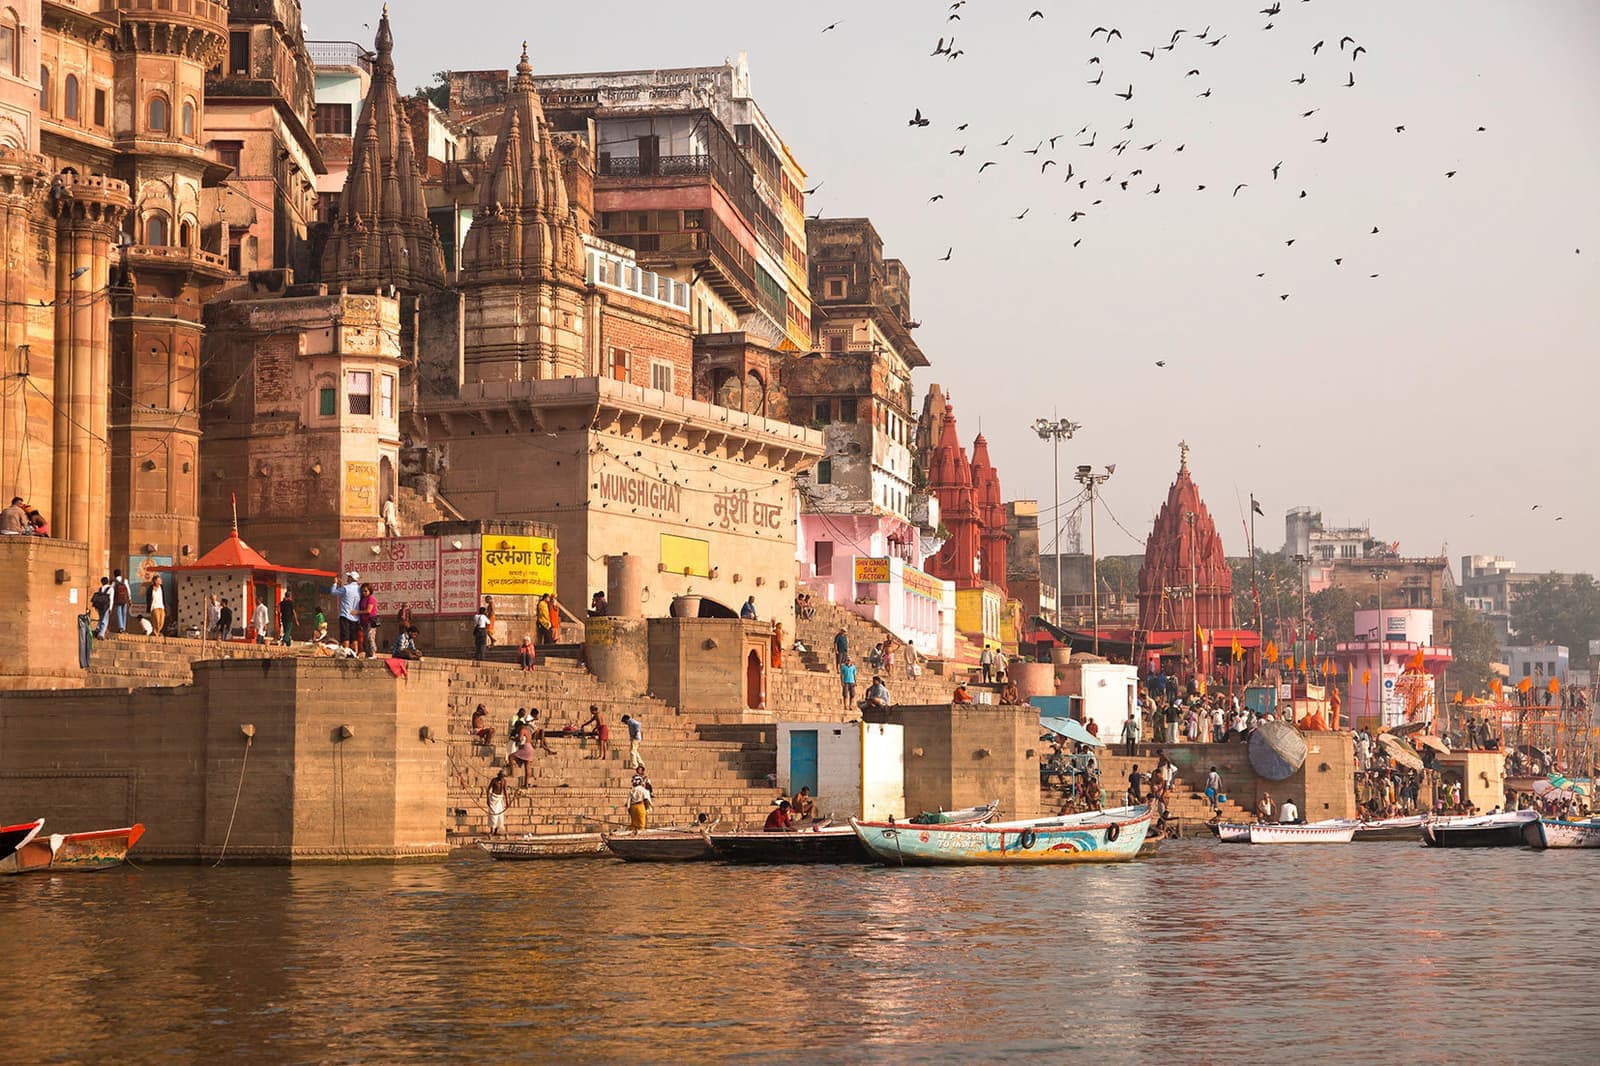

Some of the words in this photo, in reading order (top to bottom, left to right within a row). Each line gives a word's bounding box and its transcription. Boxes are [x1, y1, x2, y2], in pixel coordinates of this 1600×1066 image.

[713, 486, 749, 530] मुंशी
[753, 501, 783, 530] घाट
[485, 545, 532, 566] दरभंगा
